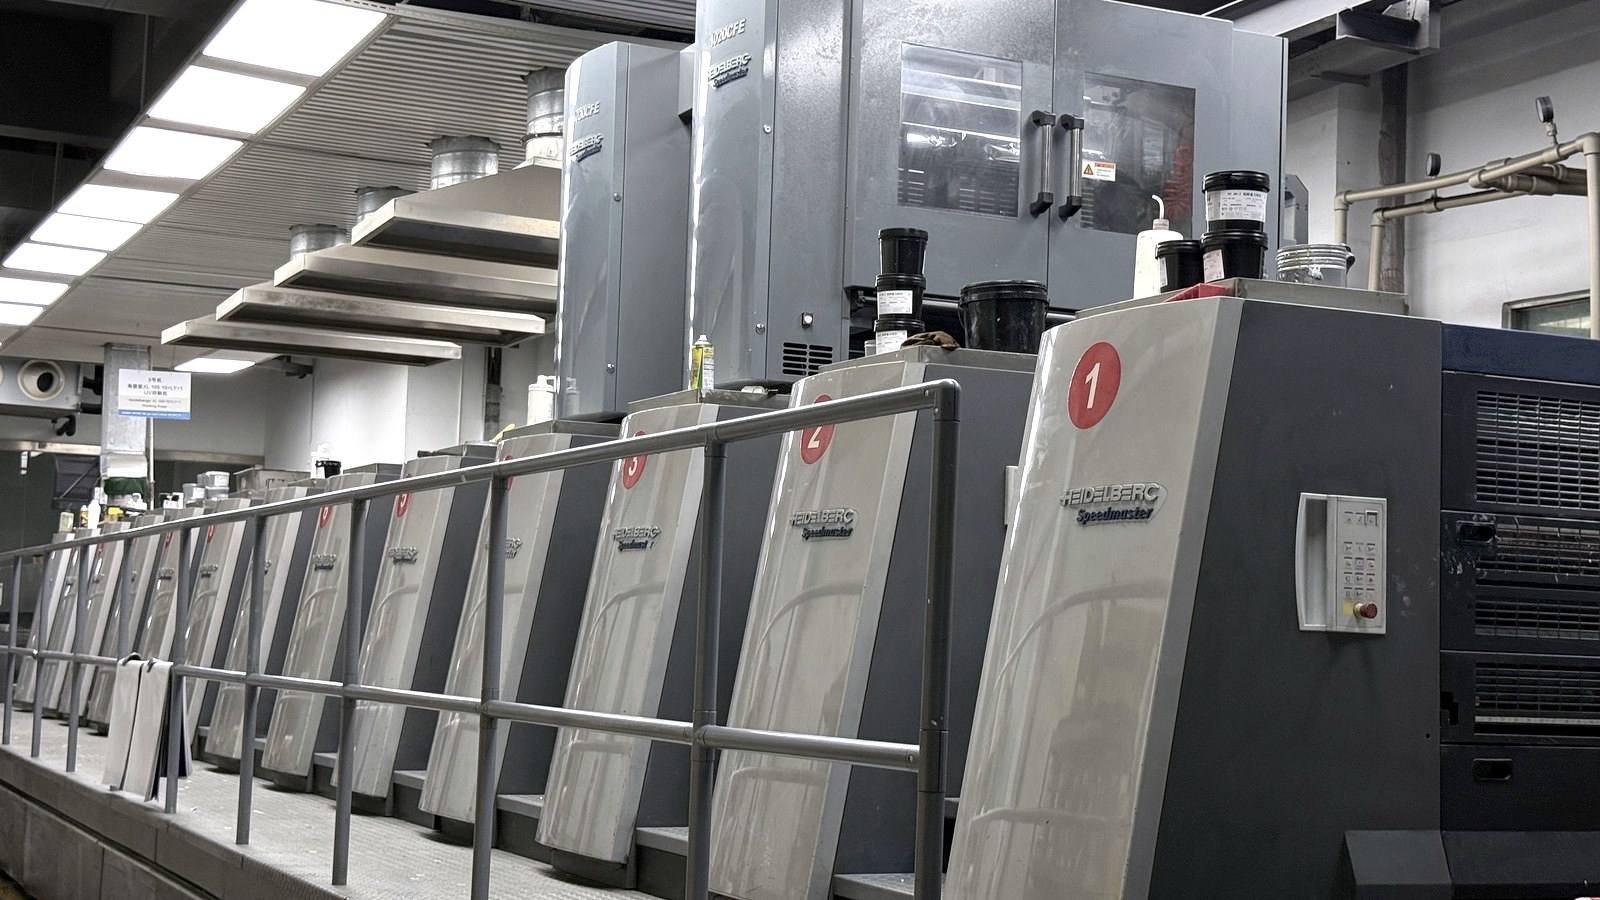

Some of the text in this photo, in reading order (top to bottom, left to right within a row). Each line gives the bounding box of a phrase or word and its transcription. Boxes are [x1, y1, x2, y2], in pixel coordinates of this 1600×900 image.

[1085, 362, 1100, 409] 1
[1059, 482, 1160, 506] HEIDELBERG
[1076, 506, 1154, 526] Speedmaster
